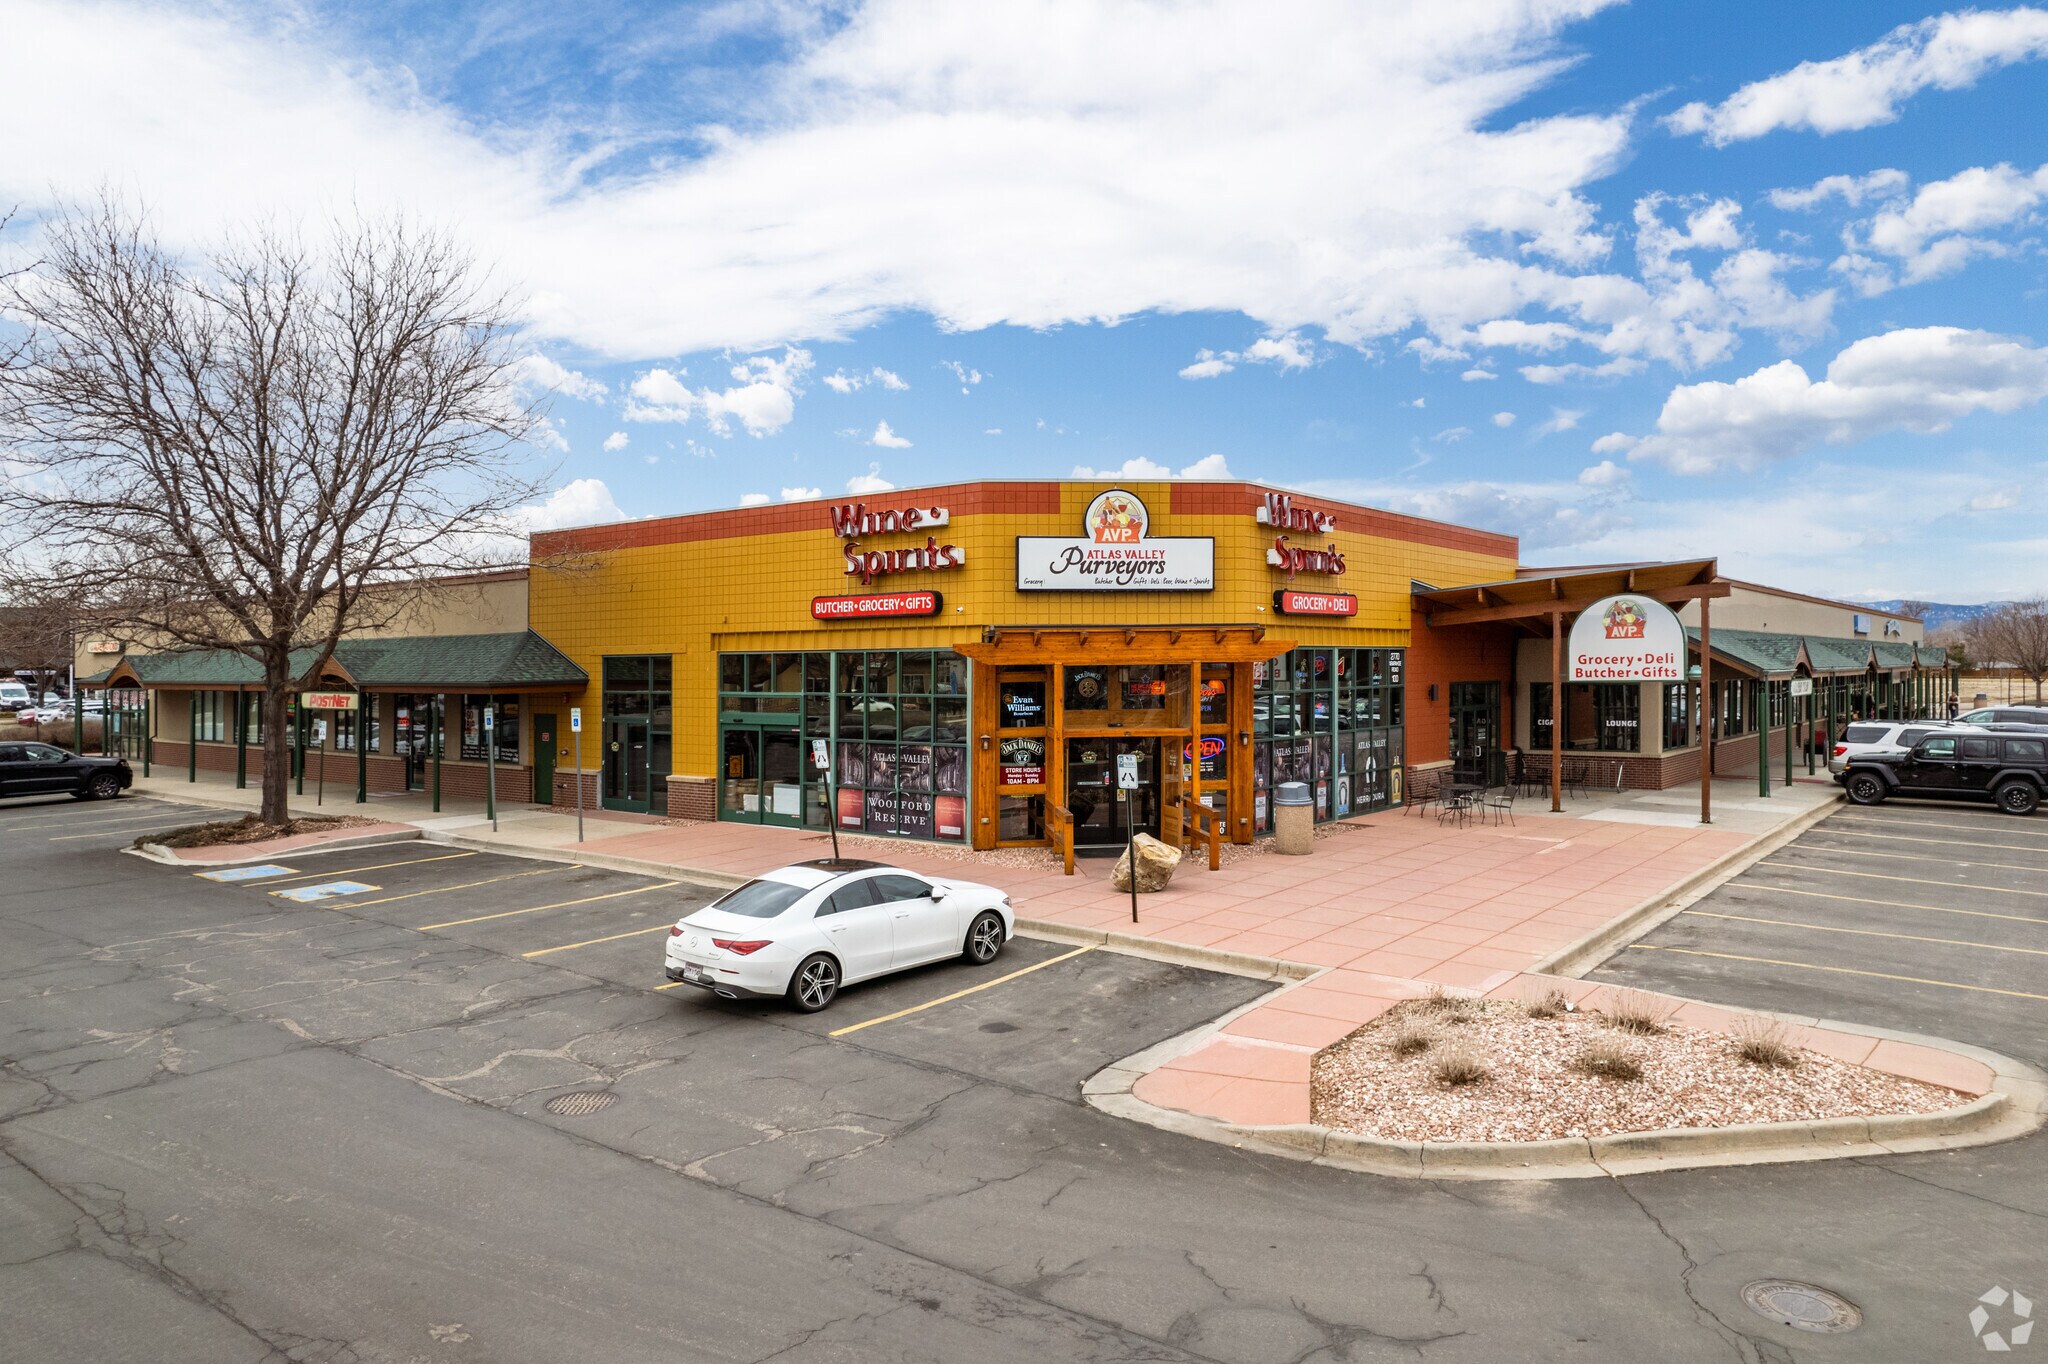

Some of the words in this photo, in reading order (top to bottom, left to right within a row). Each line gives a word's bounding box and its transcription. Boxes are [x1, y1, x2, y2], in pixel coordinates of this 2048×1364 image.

[1265, 492, 1326, 533] Wine
[830, 503, 922, 538] Wine
[1101, 528, 1132, 542] AVP
[843, 536, 958, 585] Spirits
[1087, 550, 1121, 559] ATLAS
[1126, 550, 1165, 559] VALLEY
[1275, 535, 1346, 580] Spirits
[1050, 546, 1166, 586] Purveyors
[1023, 577, 1044, 587] Grocery
[1094, 577, 1114, 585] Butcher
[1132, 577, 1147, 586] Gifts
[1150, 577, 1160, 585] Deli
[1175, 577, 1188, 585] Wine
[1194, 577, 1211, 586] Spirits
[815, 601, 854, 614] BUTCHER
[859, 598, 900, 612] GROCERY
[905, 596, 932, 609] GIFTS
[1292, 596, 1328, 610] GROCERY
[1333, 599, 1349, 611] DELI
[1611, 626, 1637, 637] AVP
[1578, 654, 1634, 667] Grocery
[1645, 653, 1674, 664] Deli
[1575, 667, 1631, 678] Butcher
[1642, 667, 1677, 678] Gifts
[1013, 695, 1034, 704] Evan
[1007, 703, 1042, 712] Williams
[1002, 743, 1019, 755] JACK
[873, 753, 896, 761] ATLAS
[903, 754, 931, 764] VALLEY
